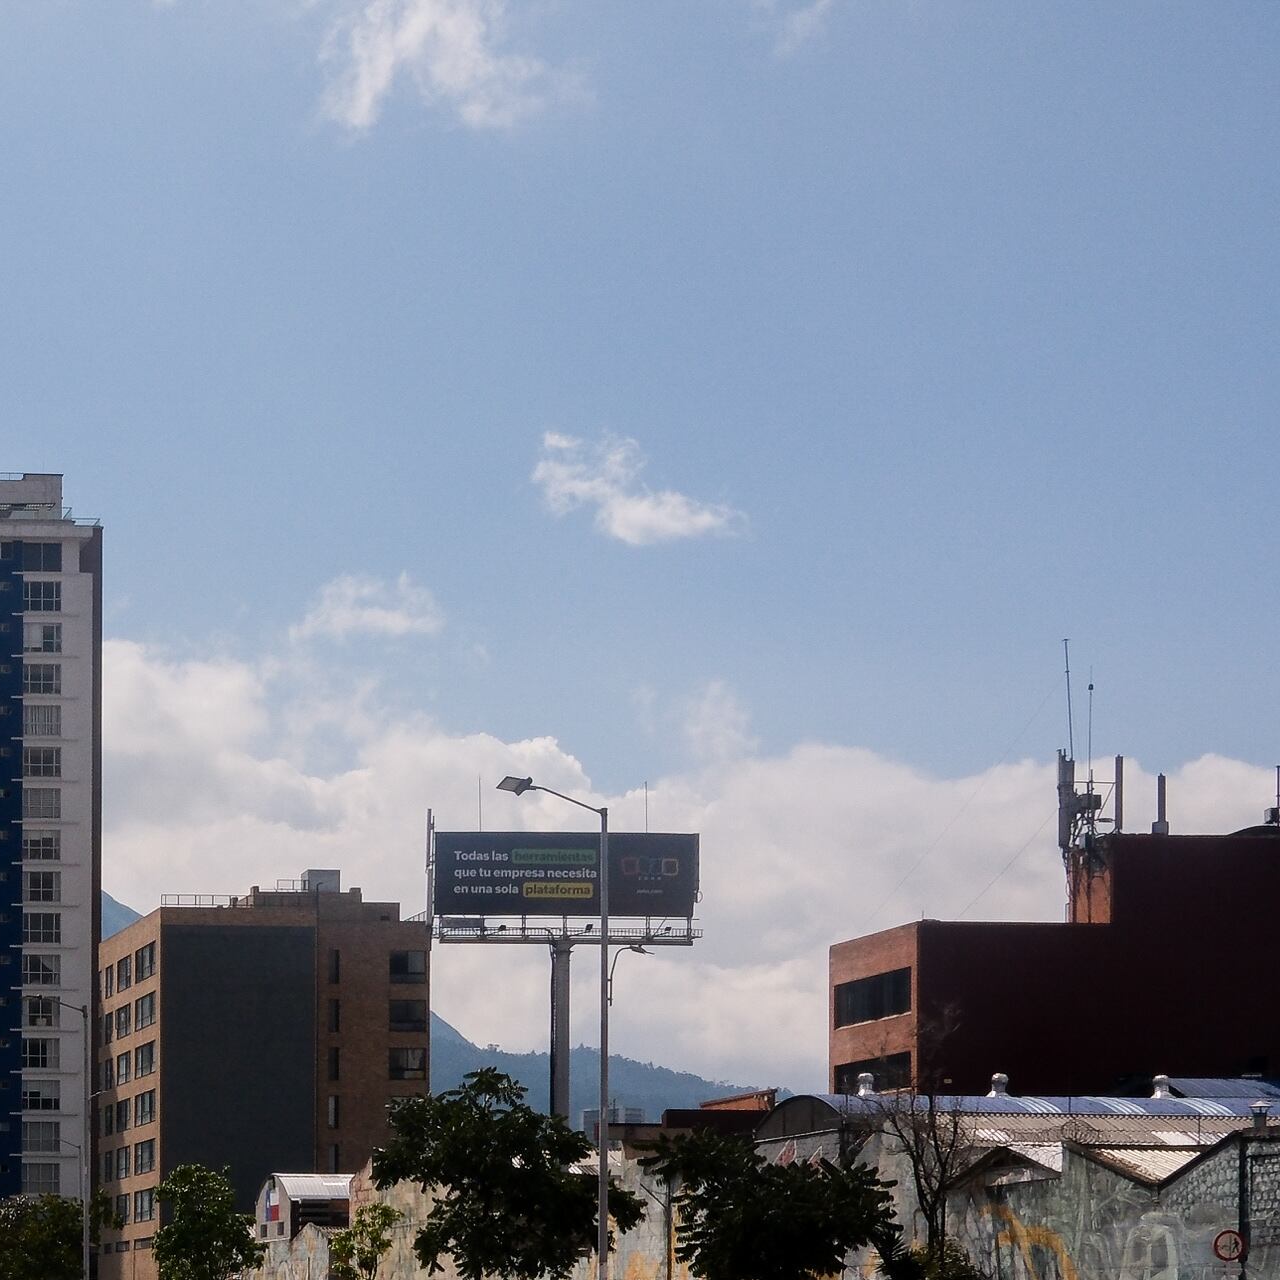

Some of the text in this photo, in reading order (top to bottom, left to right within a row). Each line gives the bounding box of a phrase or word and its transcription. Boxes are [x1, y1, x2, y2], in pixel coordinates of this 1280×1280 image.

[454, 850, 594, 863] Todas las herramientas
[454, 867, 597, 879] que tu empresa necesita
[454, 884, 591, 896] en una sola plataforma
